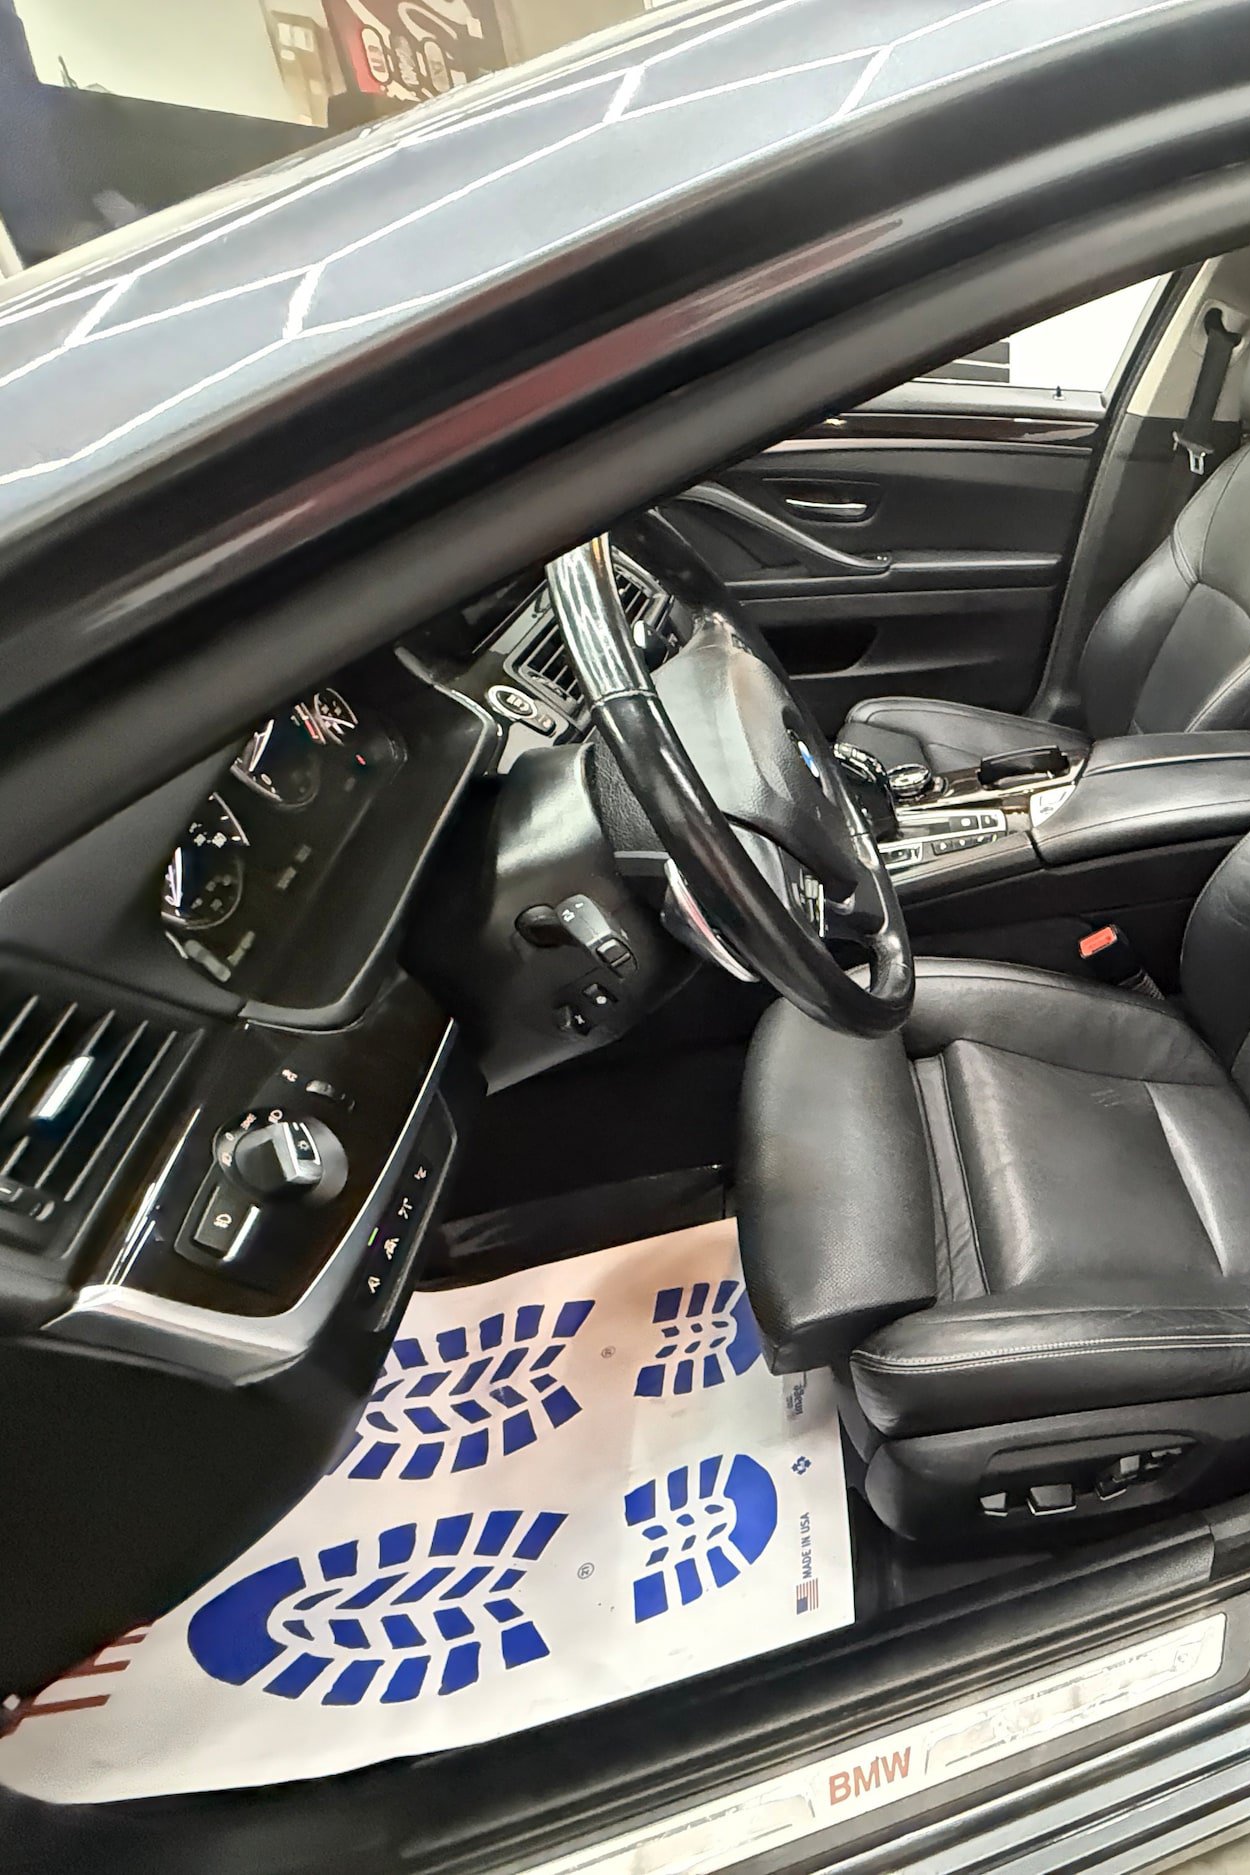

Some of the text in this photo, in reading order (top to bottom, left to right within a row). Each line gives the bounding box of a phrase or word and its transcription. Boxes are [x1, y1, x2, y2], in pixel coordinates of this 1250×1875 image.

[800, 1512, 812, 1579] MADE IN USA
[829, 1746, 911, 1806] BMW
